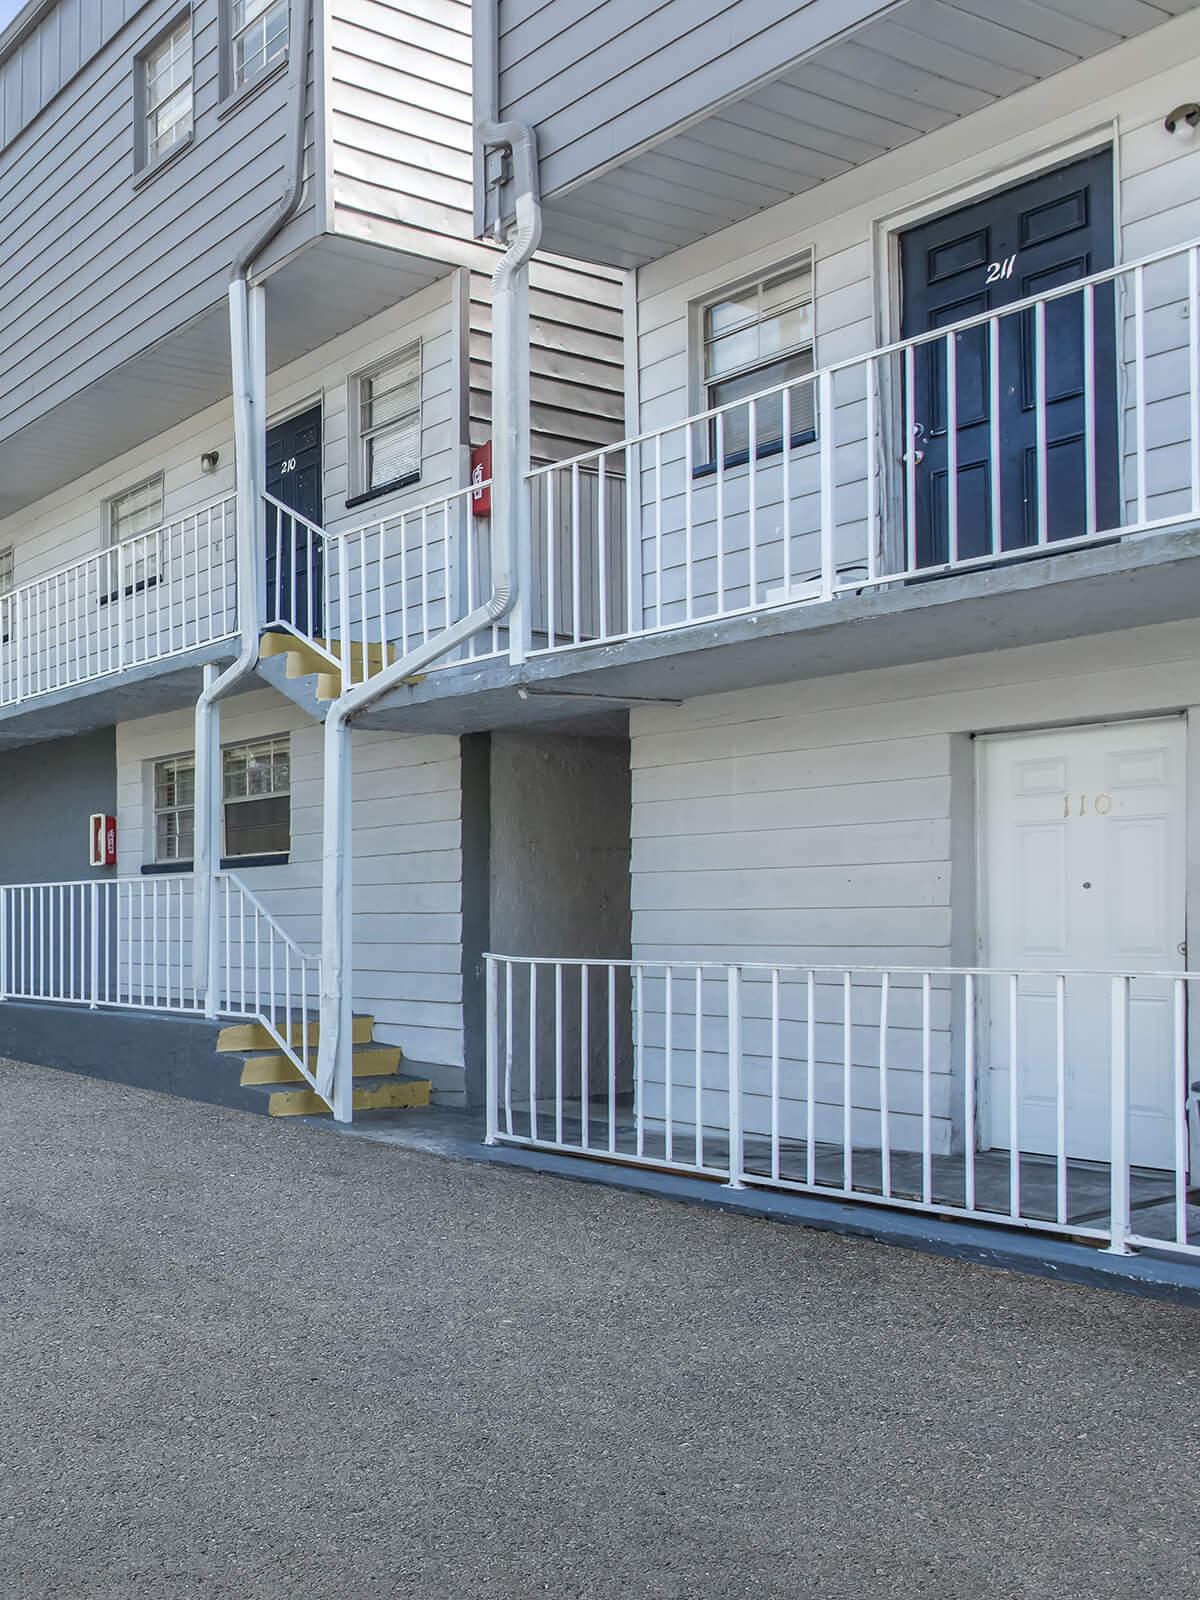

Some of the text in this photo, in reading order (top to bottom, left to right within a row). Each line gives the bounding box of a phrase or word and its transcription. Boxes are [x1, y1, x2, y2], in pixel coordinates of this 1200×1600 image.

[985, 254, 1017, 284] 211
[280, 457, 297, 474] 210
[1062, 793, 1113, 818] 110
